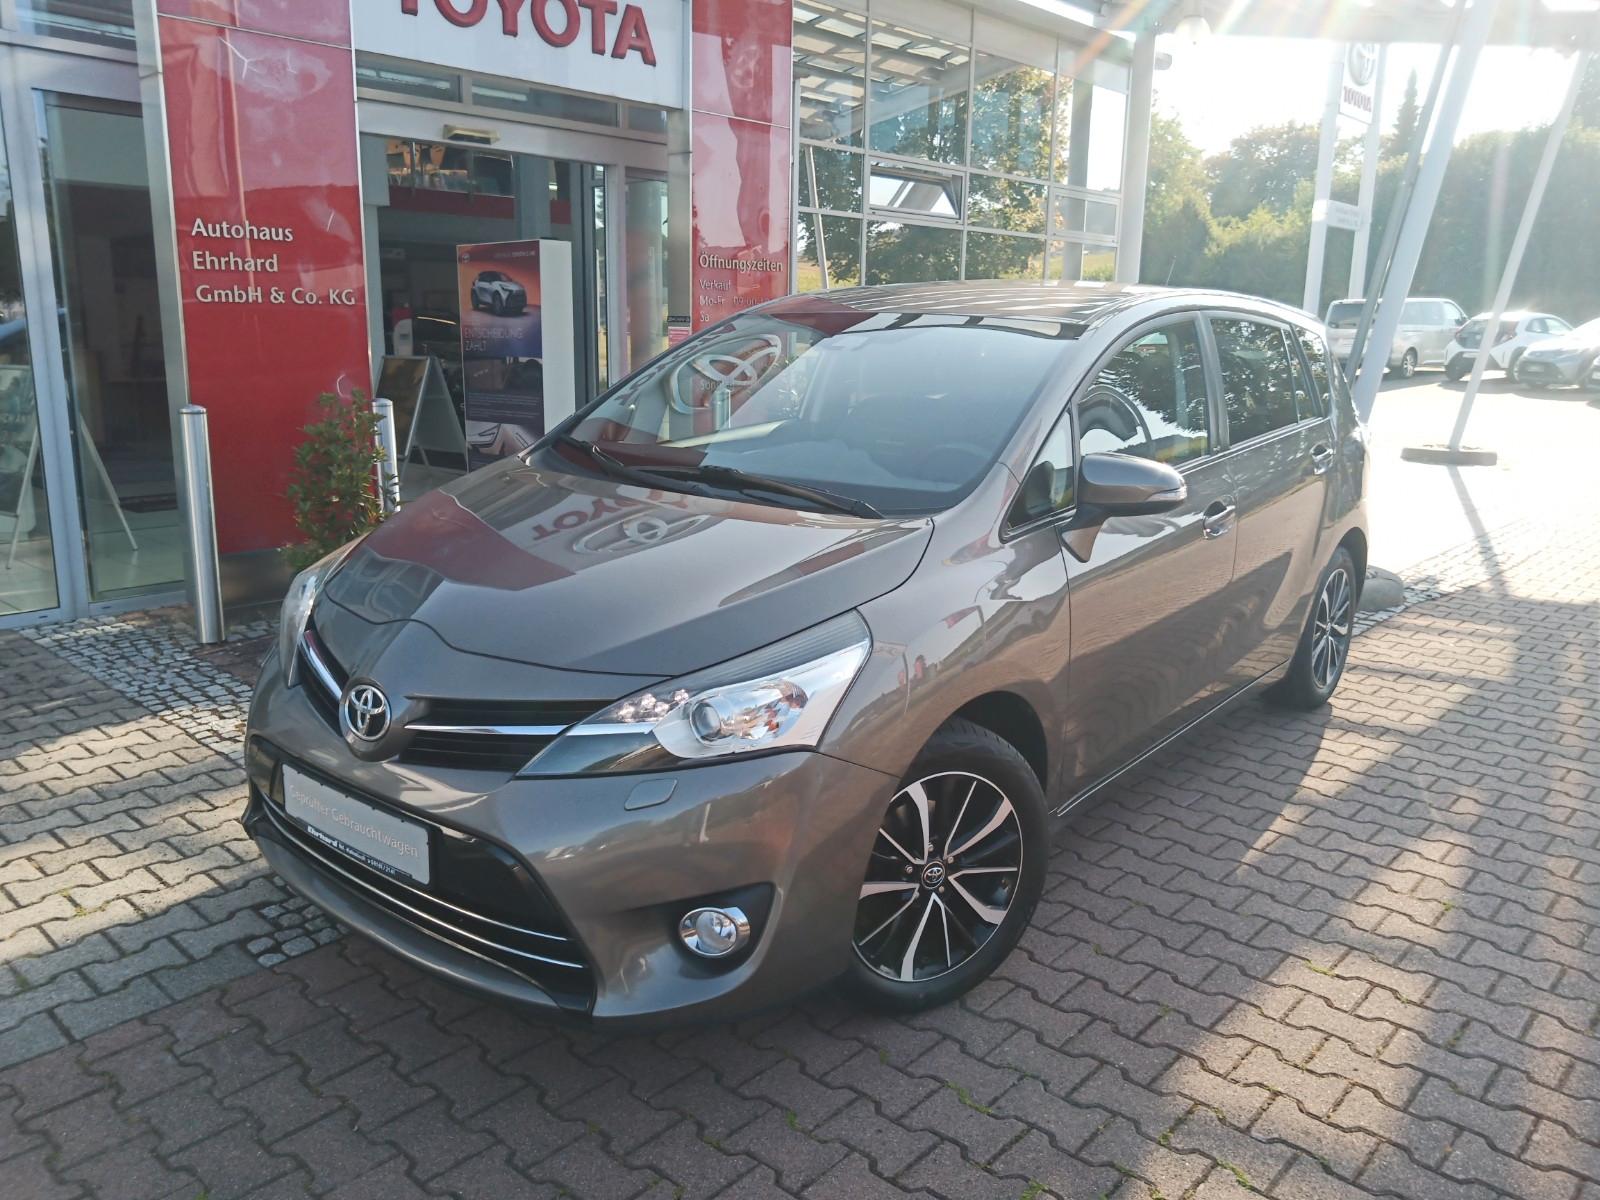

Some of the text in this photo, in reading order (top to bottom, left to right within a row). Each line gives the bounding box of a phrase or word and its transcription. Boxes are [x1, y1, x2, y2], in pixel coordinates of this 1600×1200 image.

[191, 217, 294, 242] Autohaus
[192, 250, 279, 273] Ehrhard
[699, 251, 784, 273] Öffnungszeiten
[196, 284, 356, 305] GmbH & Co. KG
[331, 809, 419, 858] Gebrauchtwagen
